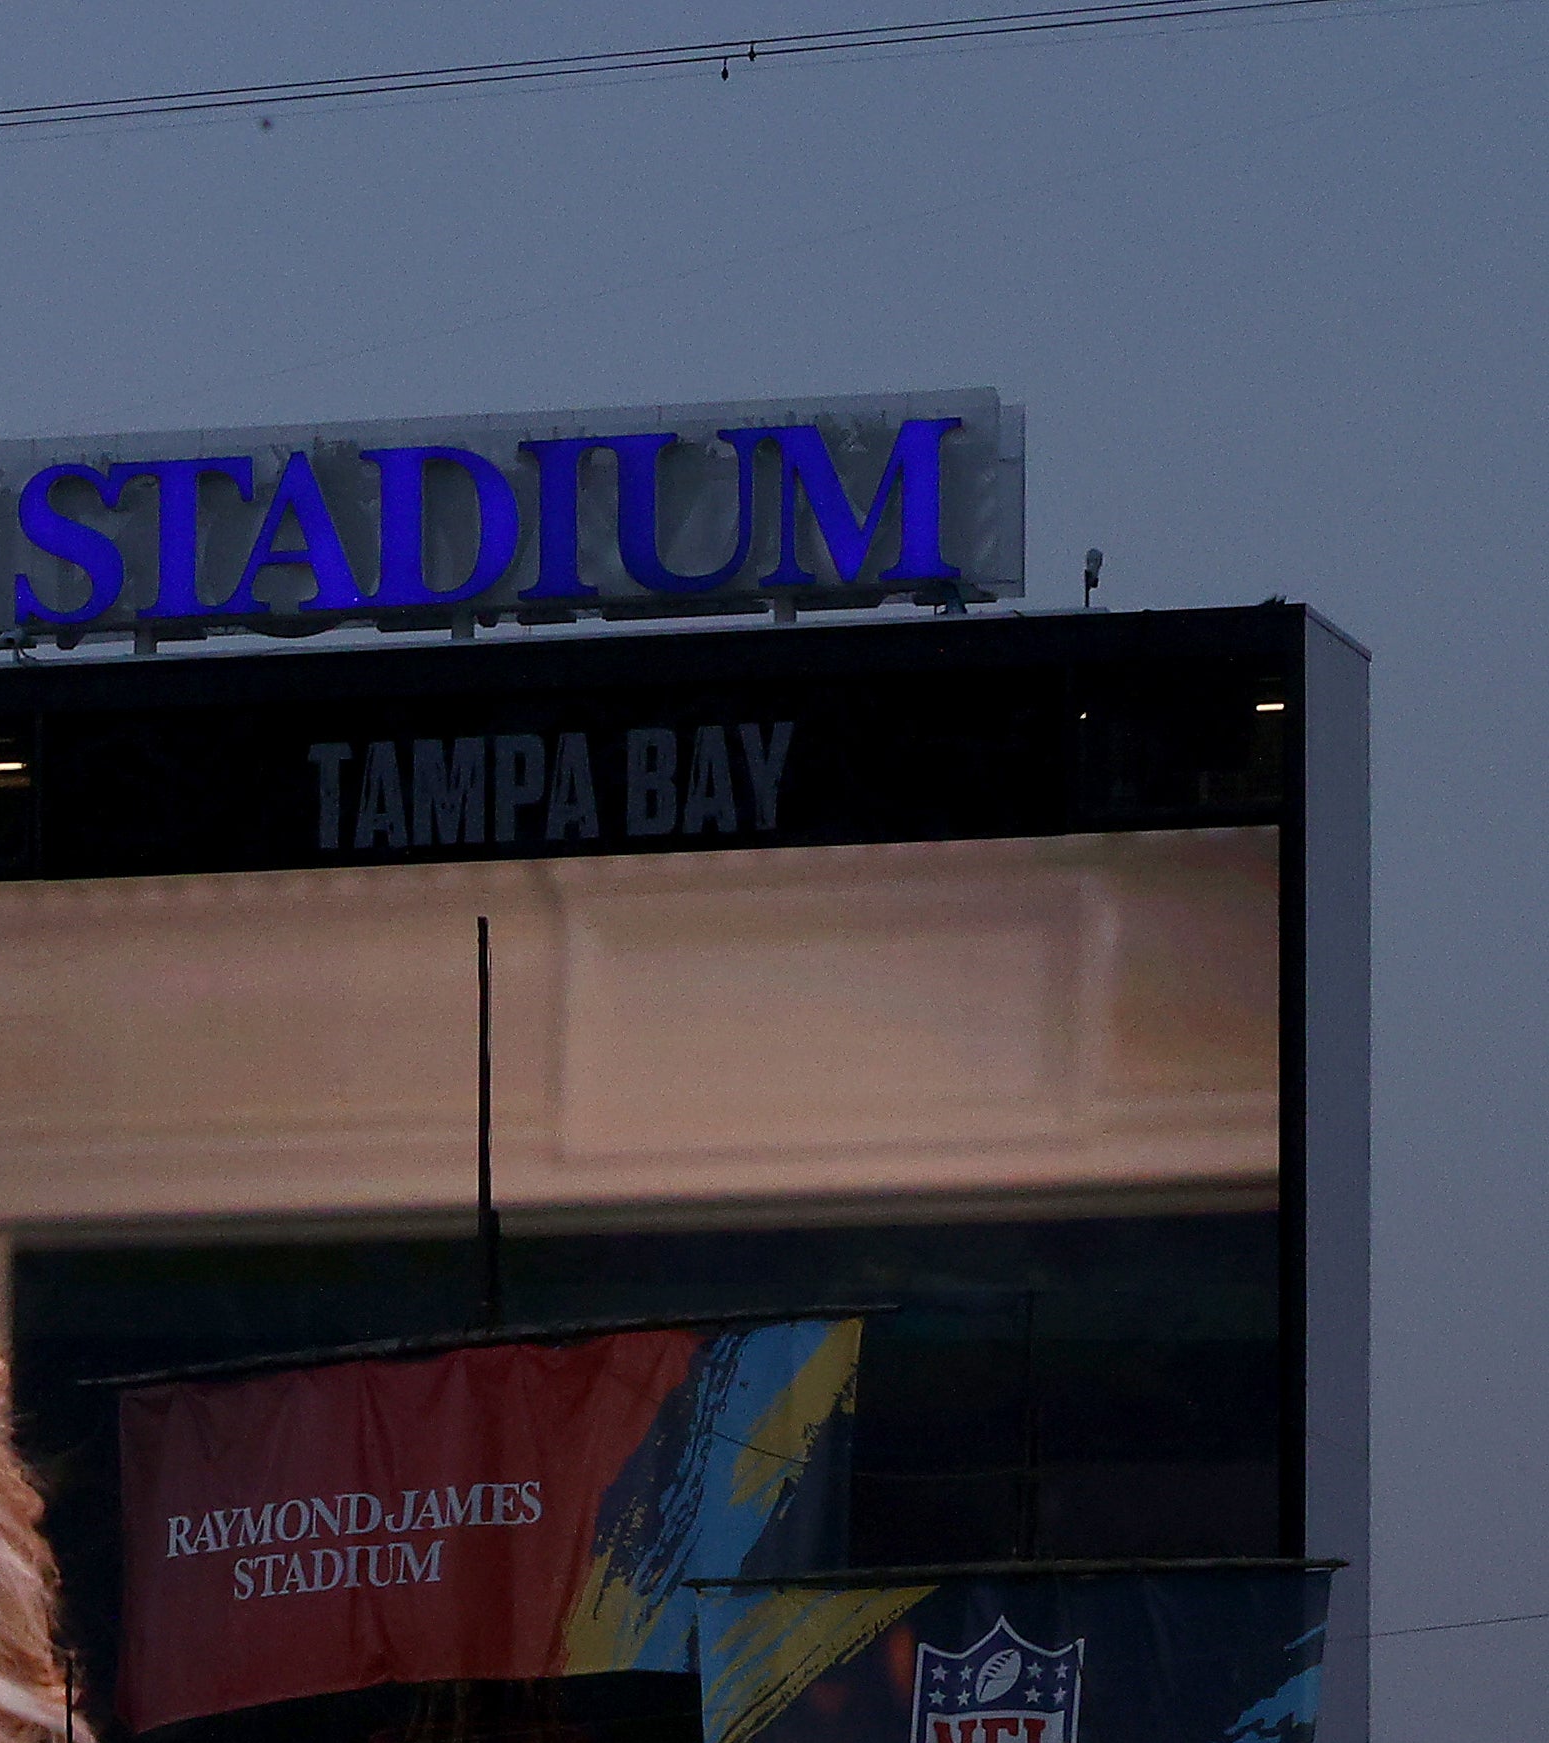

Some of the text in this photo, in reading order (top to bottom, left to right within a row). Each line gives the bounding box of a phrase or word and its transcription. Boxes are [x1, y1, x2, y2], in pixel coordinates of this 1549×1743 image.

[14, 417, 963, 624] STADIUM
[307, 720, 796, 850] TAMPA BAY
[165, 1480, 544, 1559] RAYMOND JAMES
[233, 1540, 445, 1601] STADIUM
